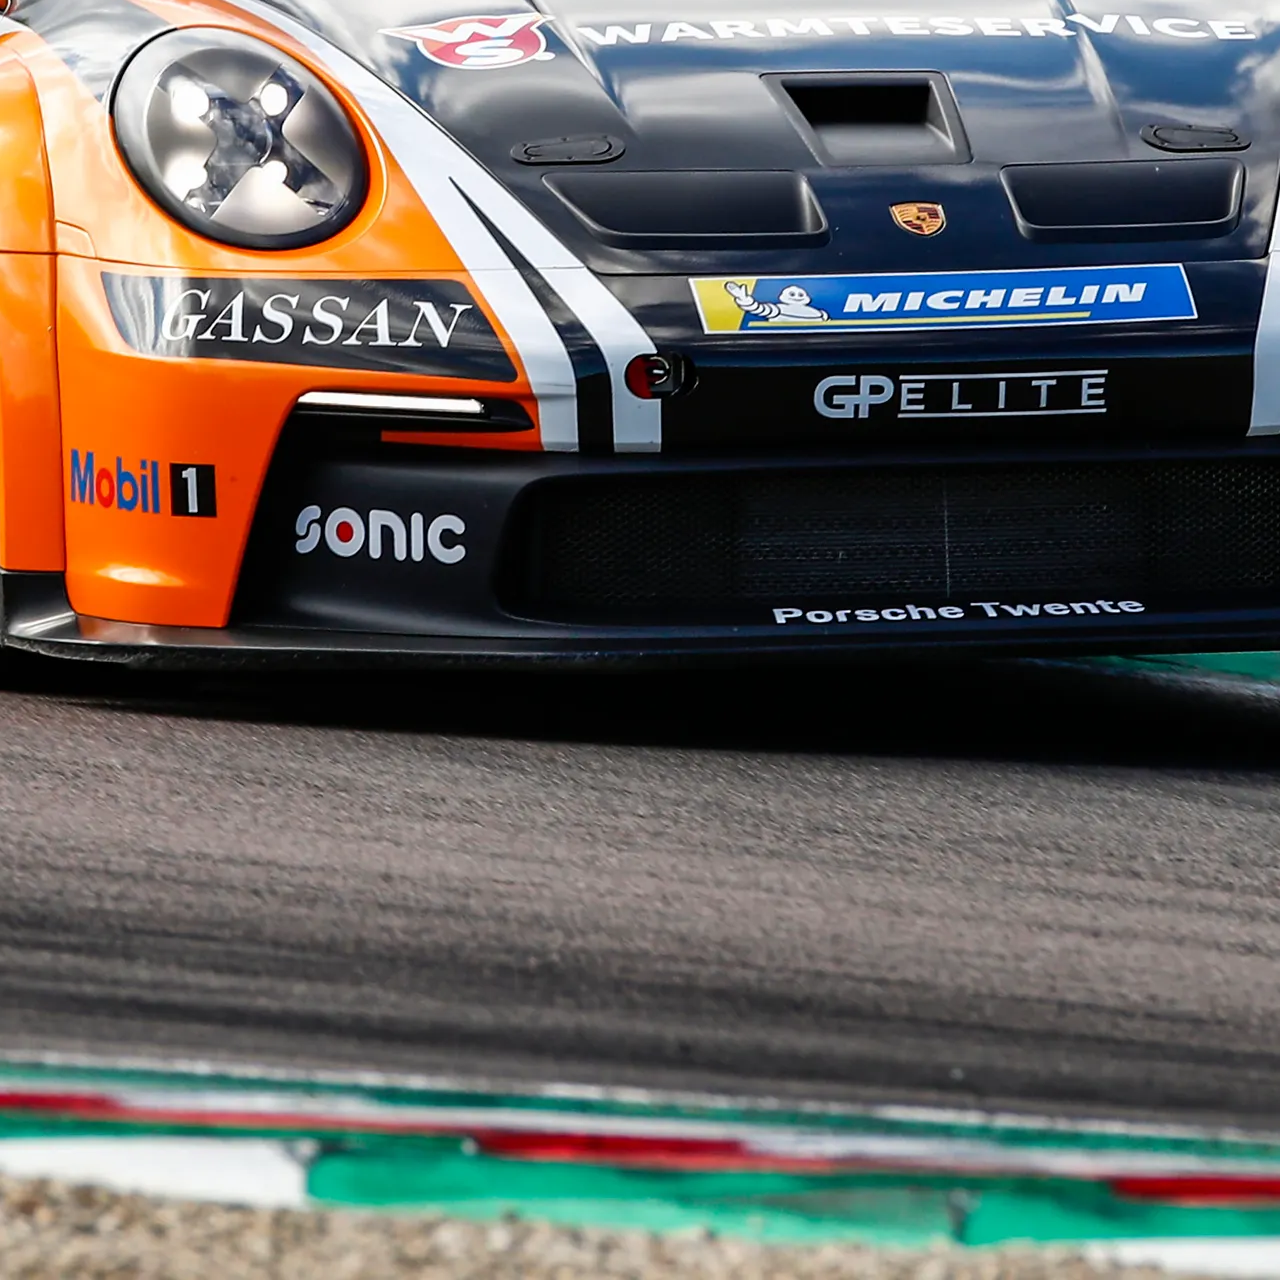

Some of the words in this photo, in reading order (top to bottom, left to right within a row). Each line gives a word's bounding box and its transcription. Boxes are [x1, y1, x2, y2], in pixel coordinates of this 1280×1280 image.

[576, 14, 1257, 46] WARMTESERVICE
[843, 282, 1148, 312] MICHELIN
[160, 289, 472, 348] GASSAN
[70, 449, 160, 514] Mobil
[179, 466, 201, 514] 1
[772, 601, 966, 625] Porsche
[970, 595, 1146, 619] Twente
